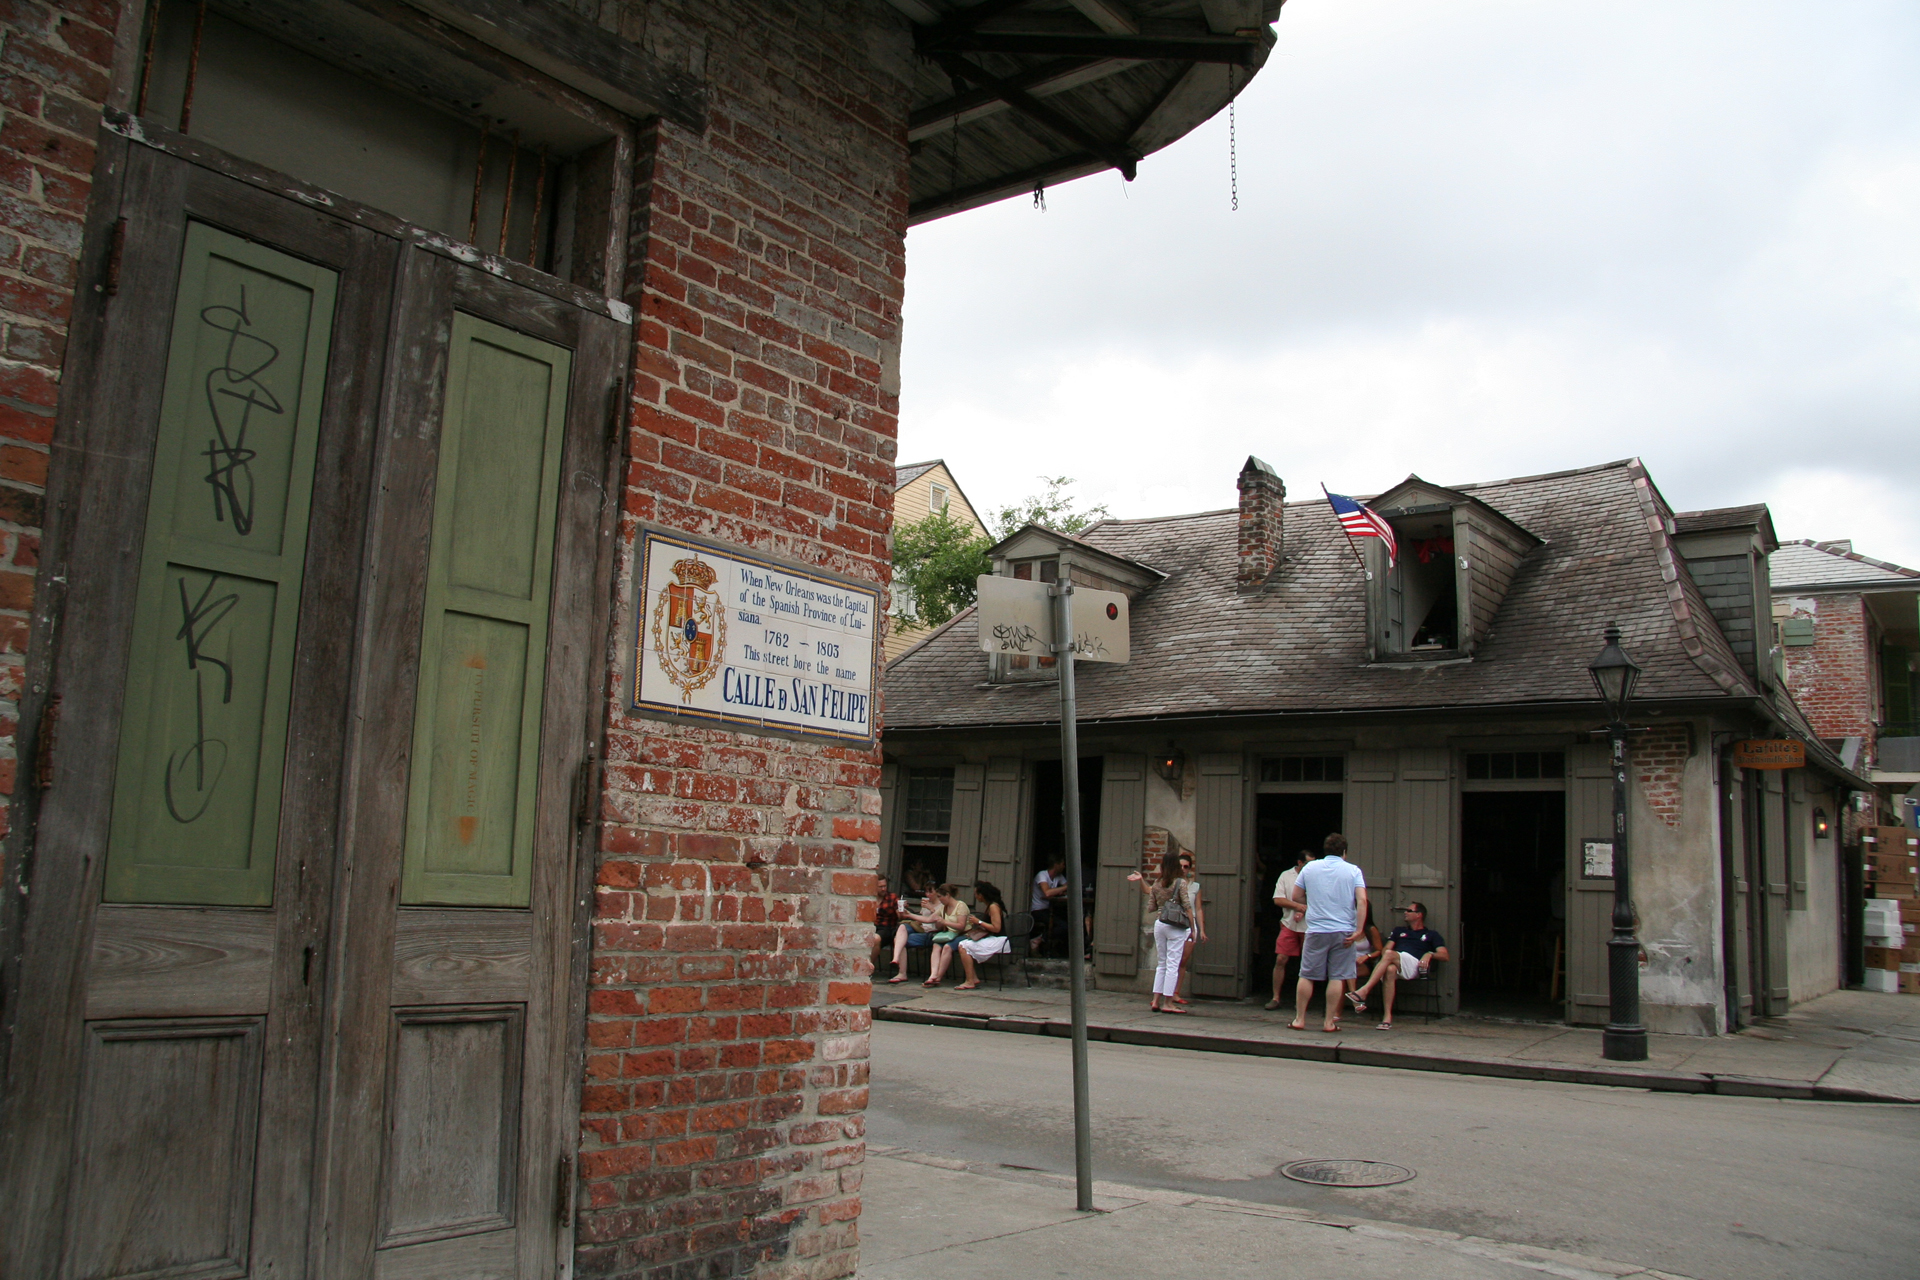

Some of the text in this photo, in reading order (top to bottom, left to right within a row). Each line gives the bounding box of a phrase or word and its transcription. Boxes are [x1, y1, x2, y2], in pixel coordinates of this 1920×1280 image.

[740, 568, 868, 614] When New Orleans was the Capital
[740, 589, 749, 603] of
[752, 591, 766, 607] the
[770, 595, 800, 615] Spanish
[803, 603, 836, 624] Province
[840, 613, 849, 626] of
[738, 609, 762, 625] siana.
[744, 644, 856, 681] This street bore the name
[764, 629, 789, 648] 1762
[817, 641, 840, 659] 1803
[723, 666, 776, 709] CALLE
[790, 677, 818, 716] SAN
[820, 683, 867, 724] FELIPE
[471, 690, 483, 746] PURSUIT
[469, 749, 479, 768] OF
[1743, 741, 1799, 755] Lafitte's
[467, 770, 477, 812] MAGIC
